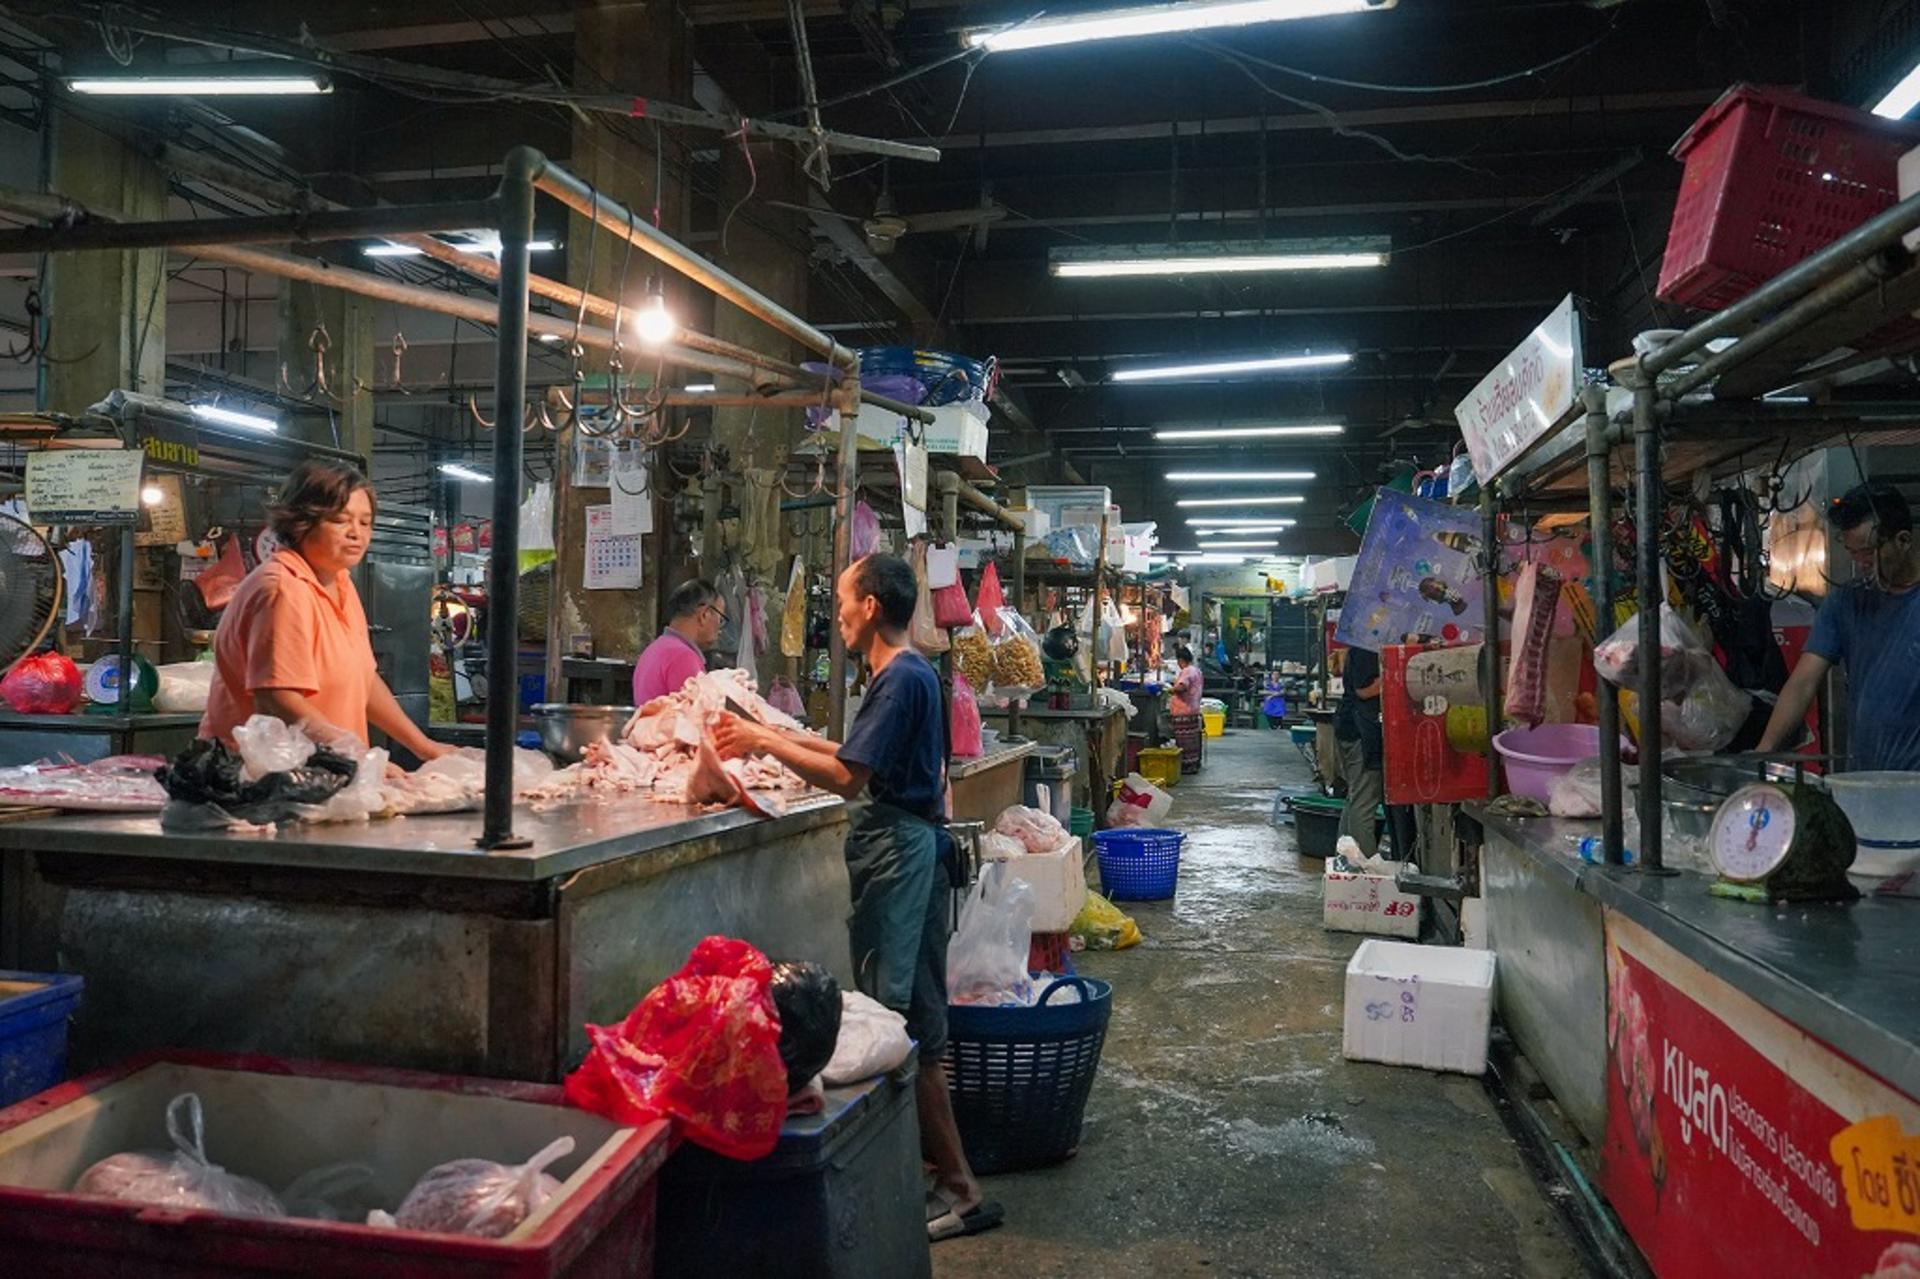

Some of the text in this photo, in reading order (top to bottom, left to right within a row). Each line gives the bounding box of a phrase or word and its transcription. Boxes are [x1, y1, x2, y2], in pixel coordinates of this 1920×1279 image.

[1664, 1037, 1729, 1155] หมูสด
[1728, 1084, 1838, 1209] ปลอดสาร ปลอดภัย
[1851, 1145, 1890, 1207] โดย
